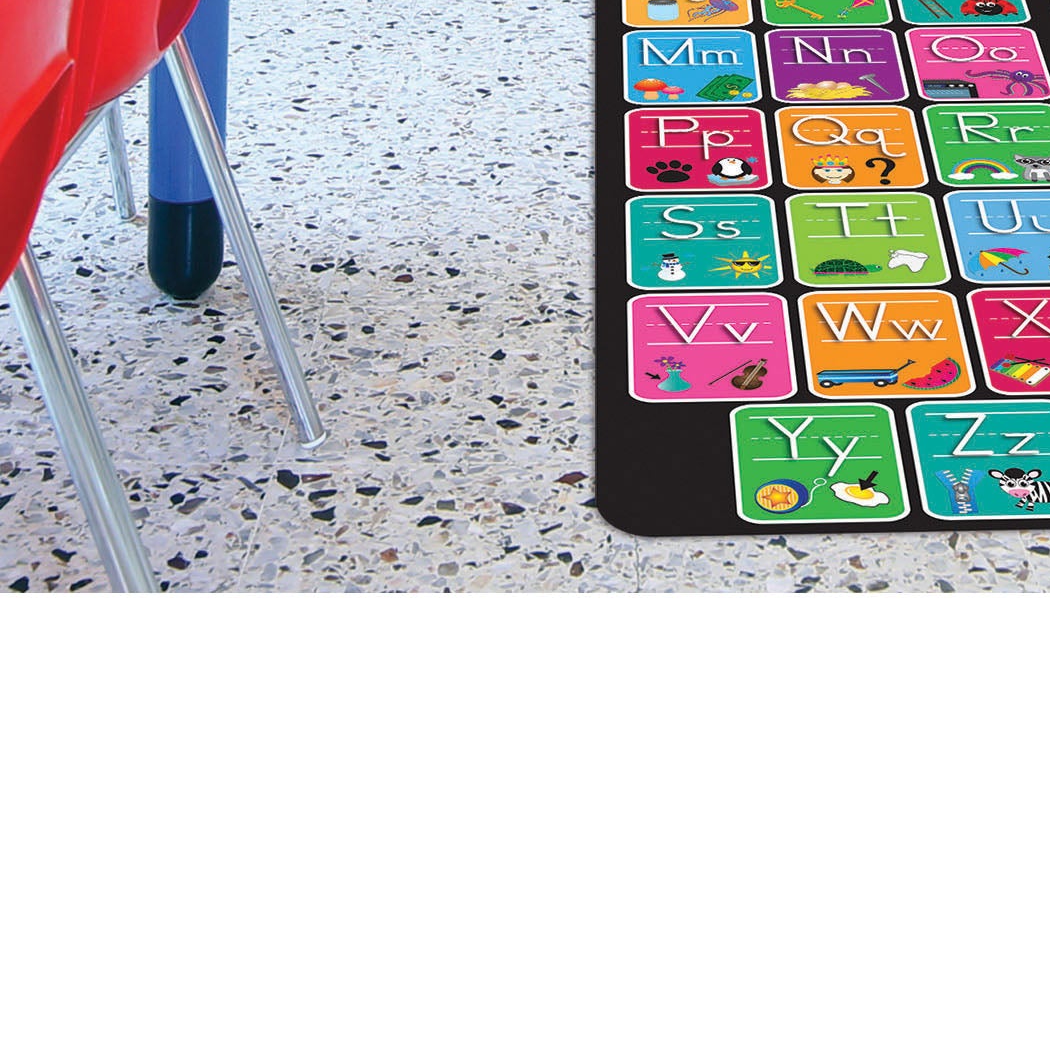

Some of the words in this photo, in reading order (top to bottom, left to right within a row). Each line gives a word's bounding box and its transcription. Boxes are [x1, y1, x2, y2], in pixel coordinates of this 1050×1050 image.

[641, 38, 739, 66] Mm
[795, 37, 874, 64] Nn
[931, 35, 1018, 62] Oo
[657, 116, 733, 160] Pp
[791, 115, 907, 157] Qq
[955, 113, 1035, 144] Rr
[865, 157, 896, 186] ?
[660, 205, 741, 239] Ss
[815, 203, 907, 236] Tt
[658, 305, 758, 344] Vv
[815, 302, 943, 341] Ww
[768, 416, 860, 477] Yy
[944, 414, 1042, 455] Zz
